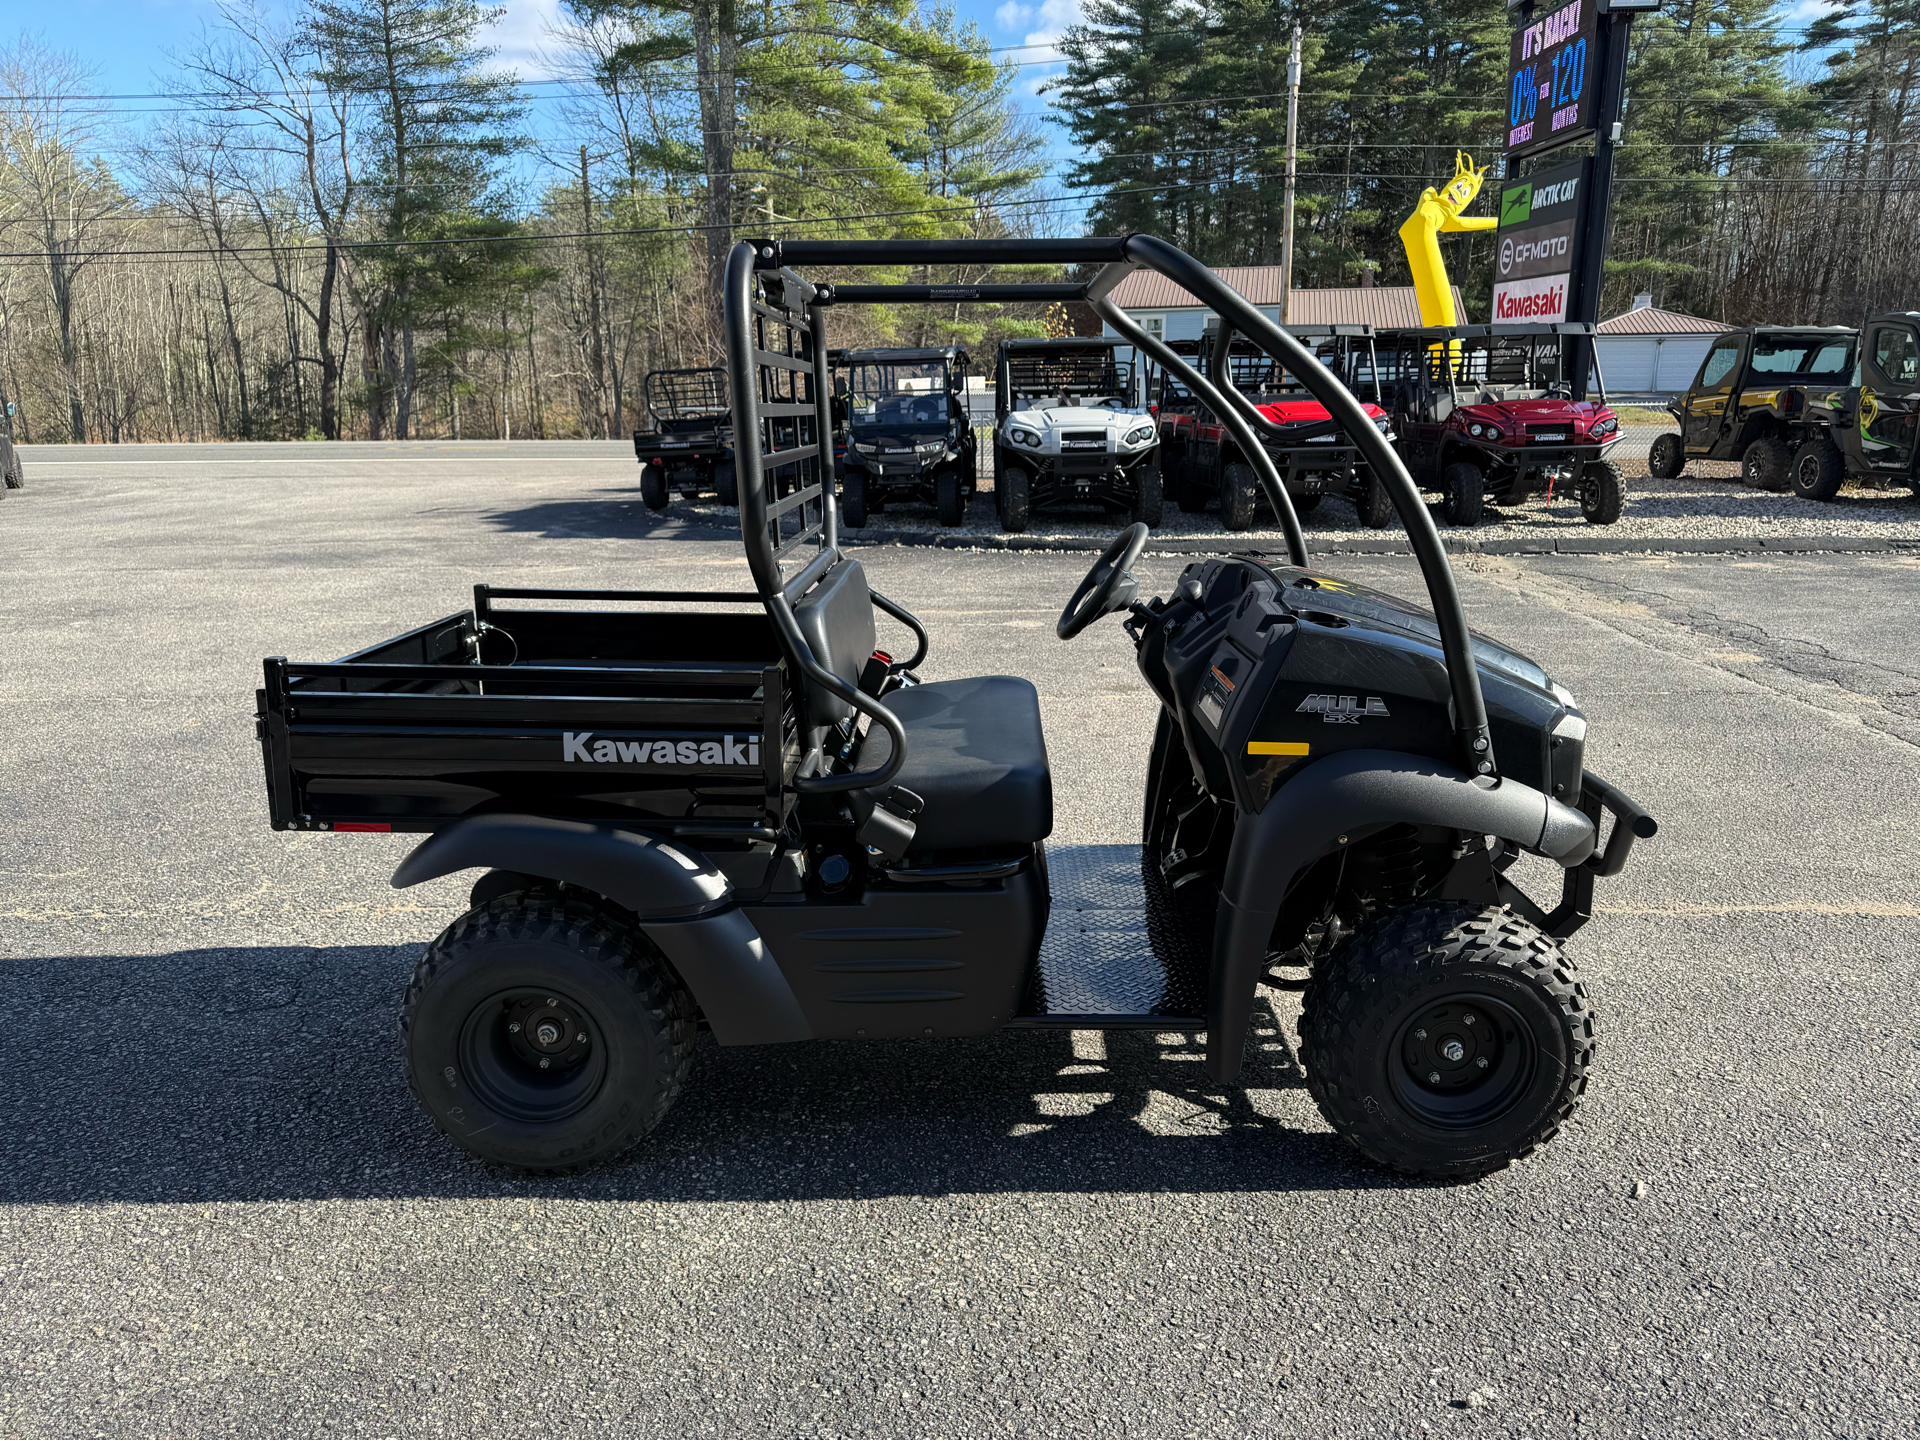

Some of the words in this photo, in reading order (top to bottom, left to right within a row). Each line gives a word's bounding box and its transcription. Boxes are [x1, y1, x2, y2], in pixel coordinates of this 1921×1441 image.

[1522, 22, 1543, 61] IT'S
[1543, 0, 1582, 49] BACK!
[1510, 62, 1537, 127] 0%
[1539, 81, 1550, 100] FOR
[1551, 36, 1587, 109] 120
[1509, 121, 1534, 147] INTEREST
[1551, 103, 1579, 131] MONTHS
[1531, 182, 1559, 210] ARCTIC
[1560, 177, 1578, 200] CAT
[1515, 237, 1568, 263] CFMOTO
[1496, 284, 1563, 318] Kawasaki
[884, 446, 913, 454] Kawasaki
[1069, 441, 1099, 449] Kawasaki
[1534, 433, 1566, 442] Kawasaki
[1295, 693, 1391, 716] MULE
[1323, 713, 1361, 725] SX
[562, 732, 760, 766] Kawasaki
